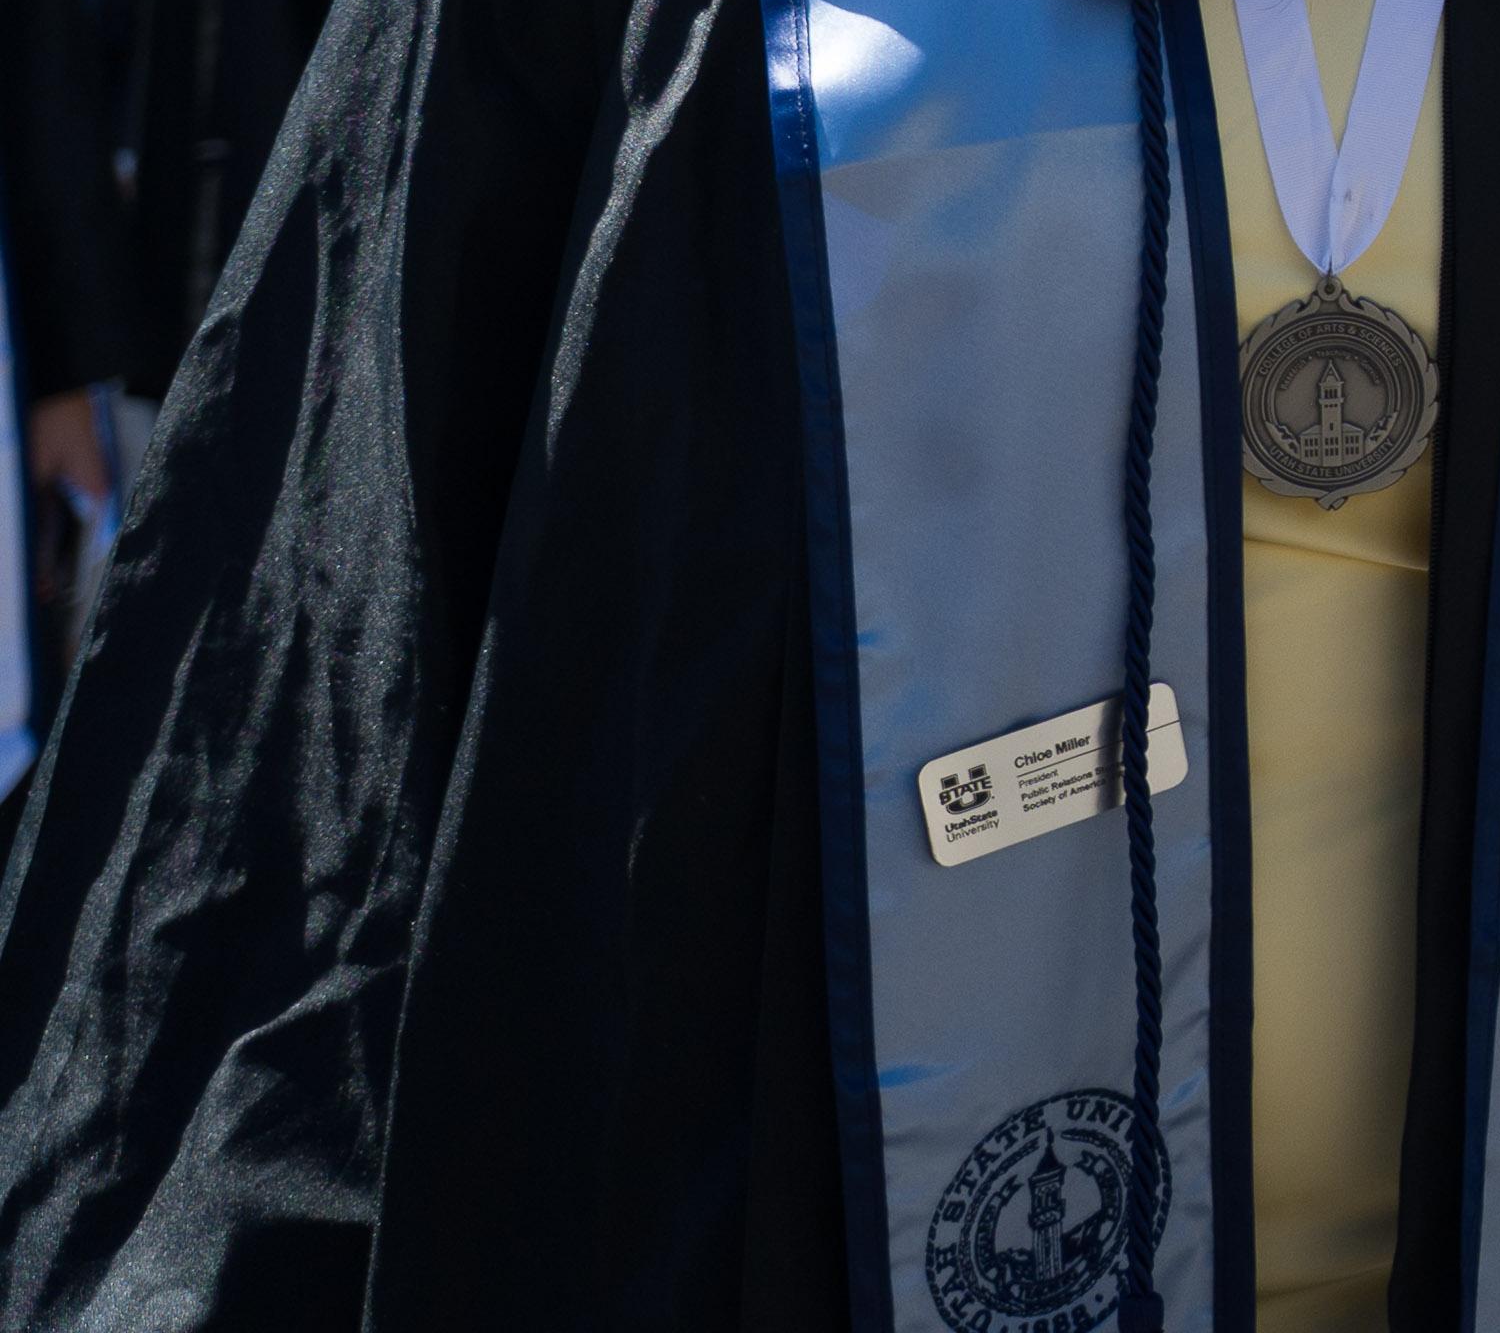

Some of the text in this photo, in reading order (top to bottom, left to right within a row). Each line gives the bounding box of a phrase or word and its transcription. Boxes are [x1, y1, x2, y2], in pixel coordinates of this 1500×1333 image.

[1259, 335, 1298, 375] COLLEGE
[1298, 329, 1315, 340] OF
[1316, 323, 1345, 334] ARTS
[1359, 329, 1401, 367] SCIENCES
[1270, 437, 1394, 478] UTAH STATE UNIVERSITY
[1014, 735, 1091, 769] Chloe Miller
[939, 775, 993, 806] STATE
[1018, 768, 1059, 788] President
[1021, 786, 1049, 802] Public
[1051, 770, 1093, 791] Relations
[1023, 795, 1056, 812] Society
[1058, 789, 1068, 800] of
[946, 818, 1000, 843] University
[942, 1108, 1046, 1224] STATE
